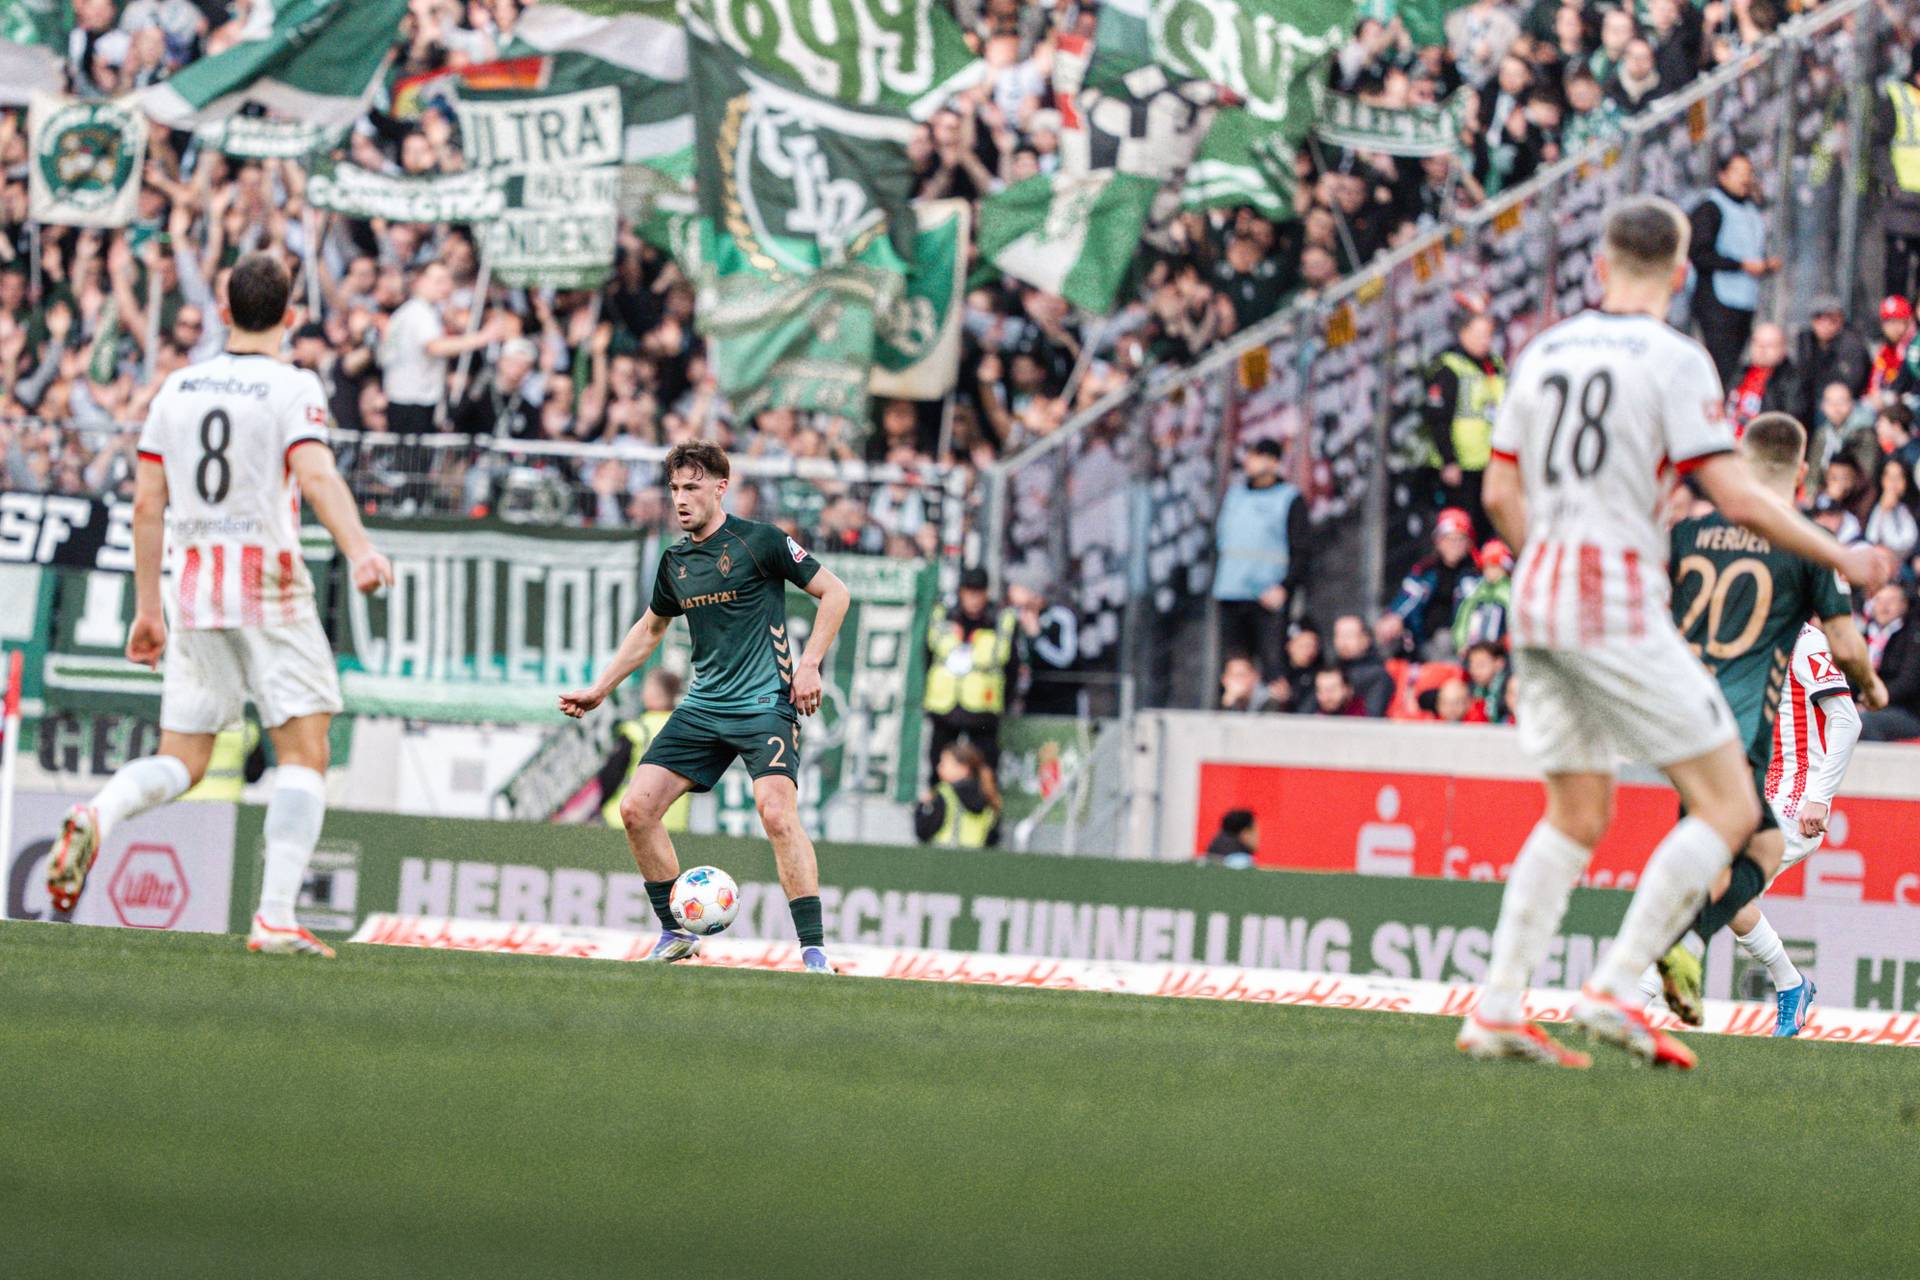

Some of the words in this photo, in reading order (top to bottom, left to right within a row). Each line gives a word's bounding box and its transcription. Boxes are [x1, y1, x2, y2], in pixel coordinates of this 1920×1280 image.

[196, 408, 231, 505] 8
[1541, 368, 1614, 486] 28
[1677, 554, 1774, 660] 20
[766, 735, 787, 768] 2
[971, 896, 1351, 975] TUNNELLING
